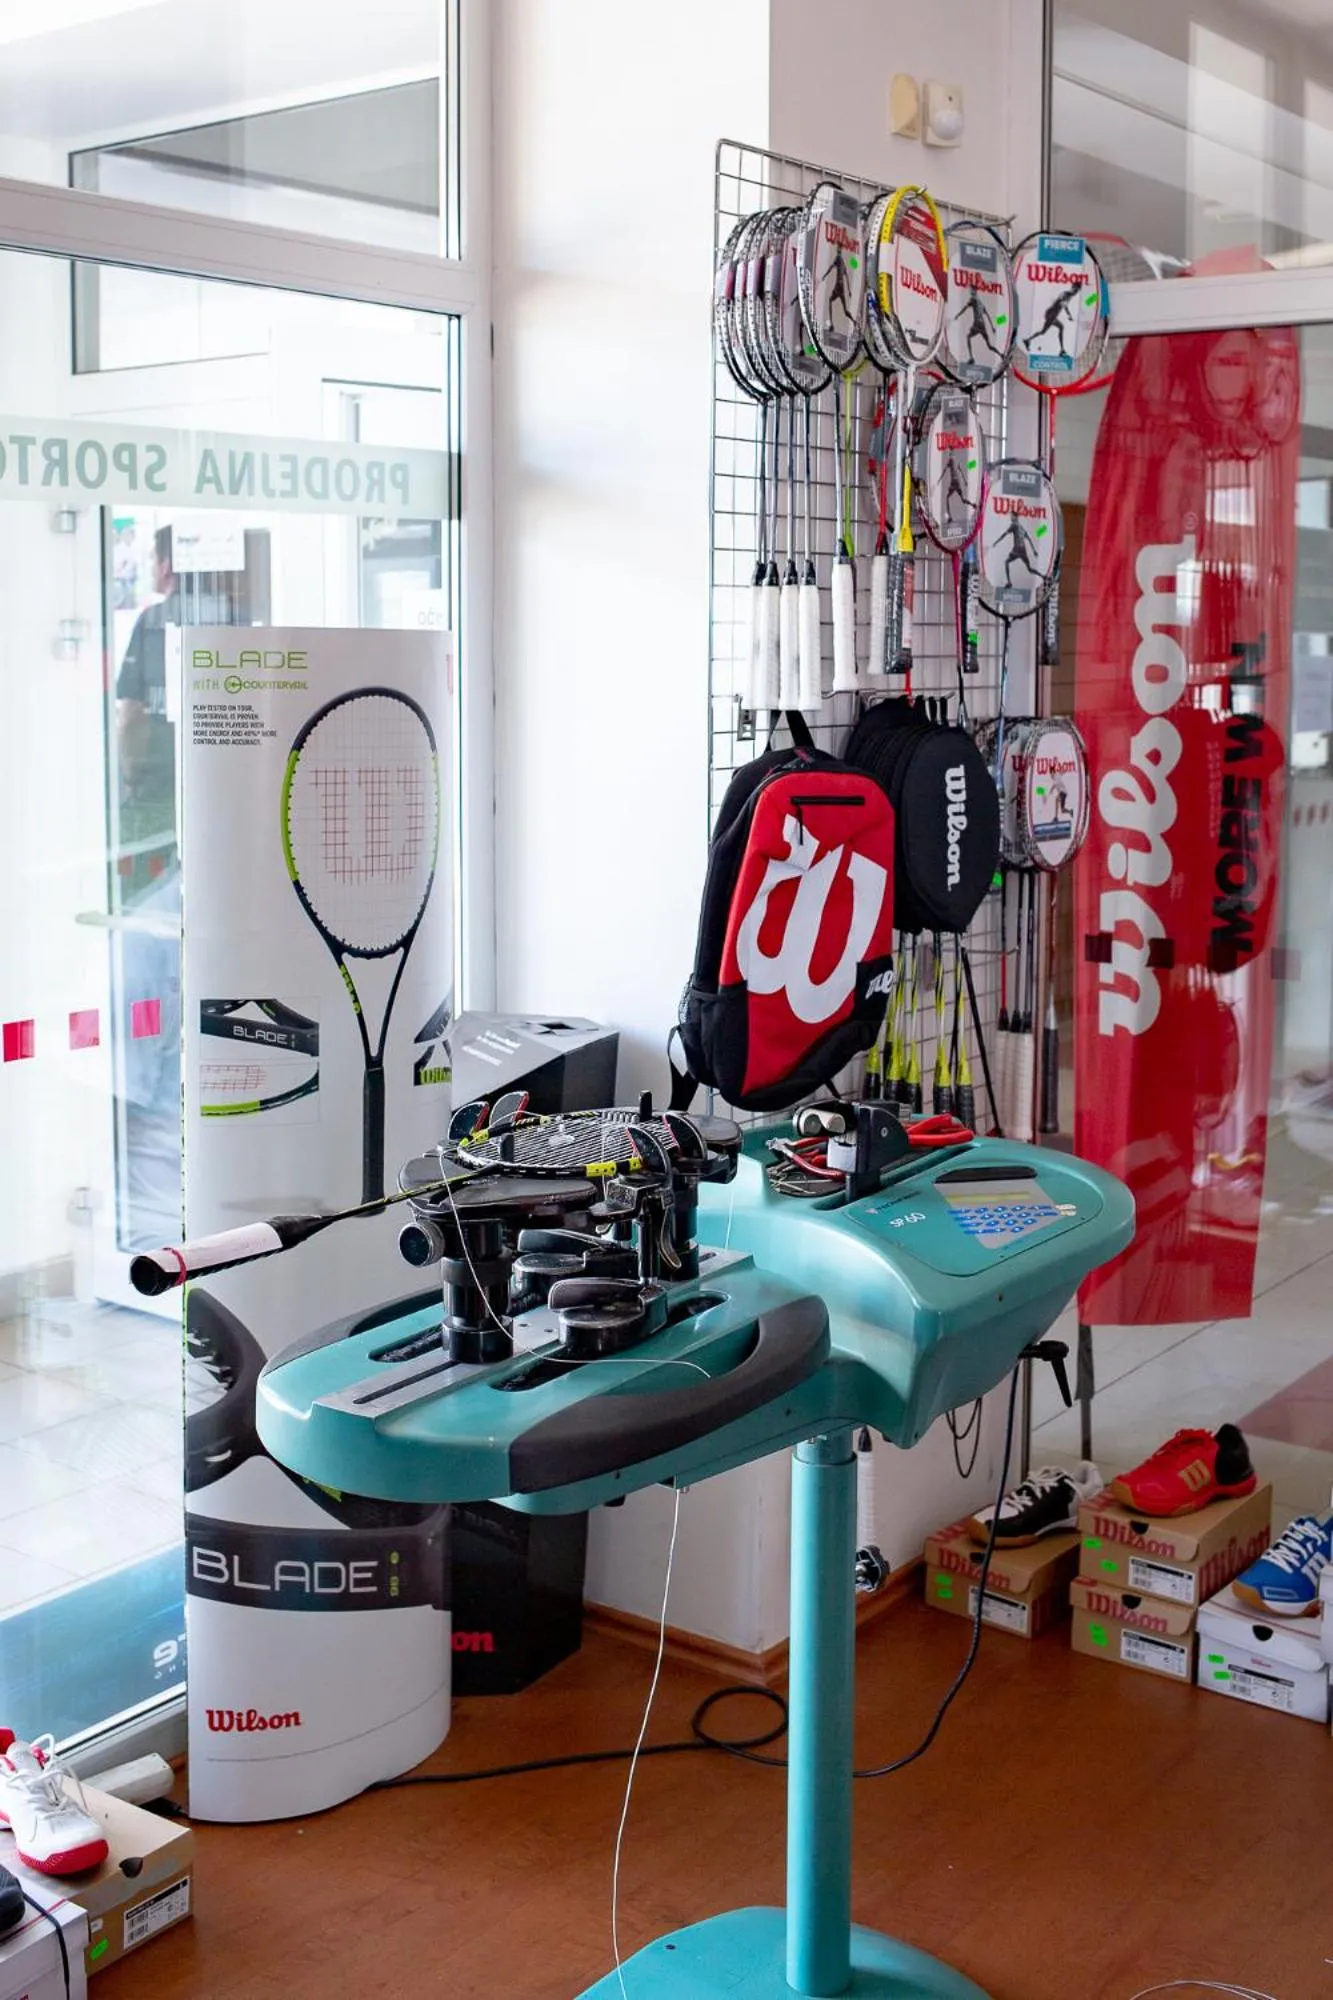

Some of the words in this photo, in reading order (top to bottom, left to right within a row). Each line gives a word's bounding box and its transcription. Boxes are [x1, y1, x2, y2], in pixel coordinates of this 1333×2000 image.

[824, 221, 860, 254] Wilson
[1044, 239, 1080, 251] PIERCE
[965, 245, 992, 259] BLAZE
[900, 266, 938, 302] Wilson
[953, 268, 1004, 295] Wilson
[1026, 263, 1090, 286] Wilson
[935, 431, 975, 452] Wilson
[1008, 473, 1037, 485] BLAZE
[992, 496, 1048, 520] Wilson
[192, 650, 308, 669] BLADE
[1036, 755, 1076, 775] Wilson
[1100, 533, 1196, 1037] Wilson
[944, 764, 968, 888] Wilson
[232, 1025, 288, 1045] BLADE
[1093, 1516, 1176, 1558] Wilson
[192, 1545, 379, 1594] BLADE
[1086, 1591, 1168, 1633] Wilson
[205, 1709, 302, 1733] Wilson
